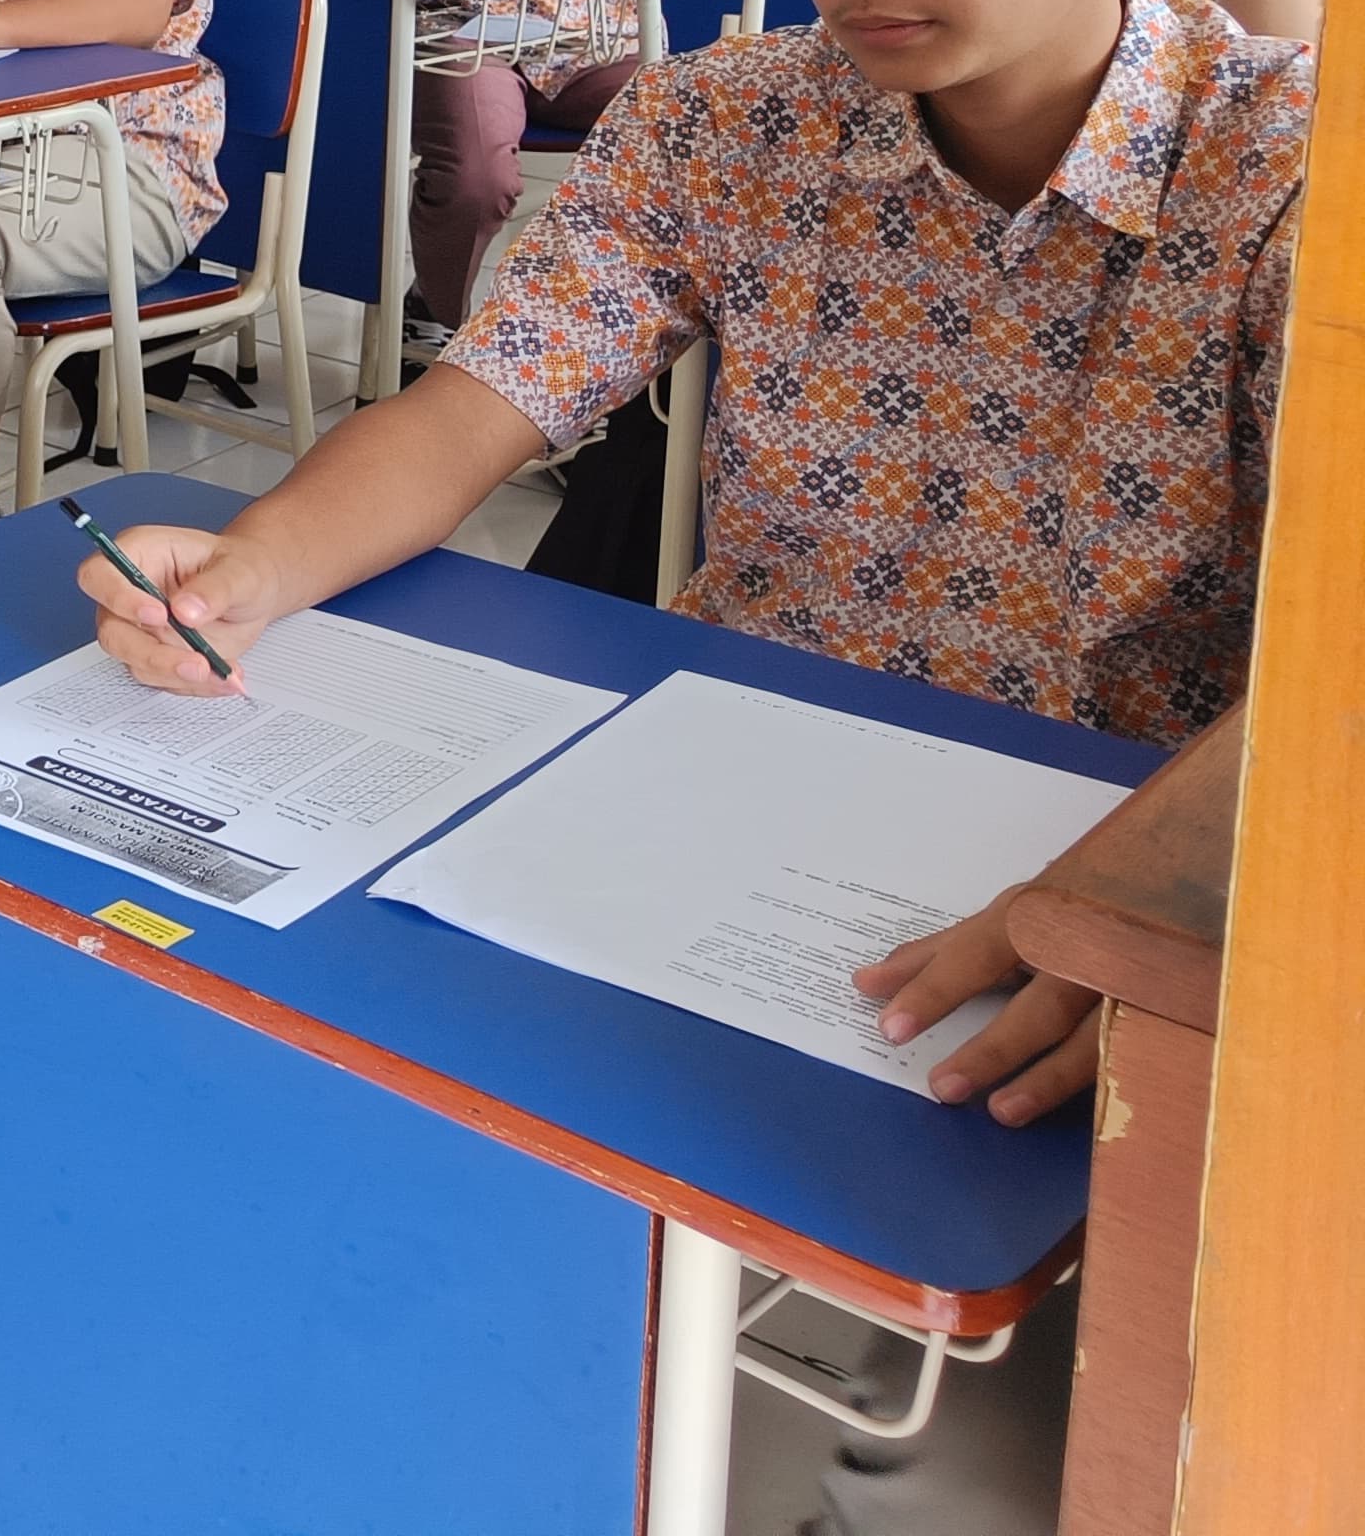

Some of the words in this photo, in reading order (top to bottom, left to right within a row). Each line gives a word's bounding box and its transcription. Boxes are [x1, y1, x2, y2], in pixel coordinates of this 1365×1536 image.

[43, 759, 128, 799] PESERTA
[128, 793, 211, 828] DAFTAR
[169, 843, 208, 860] SMP
